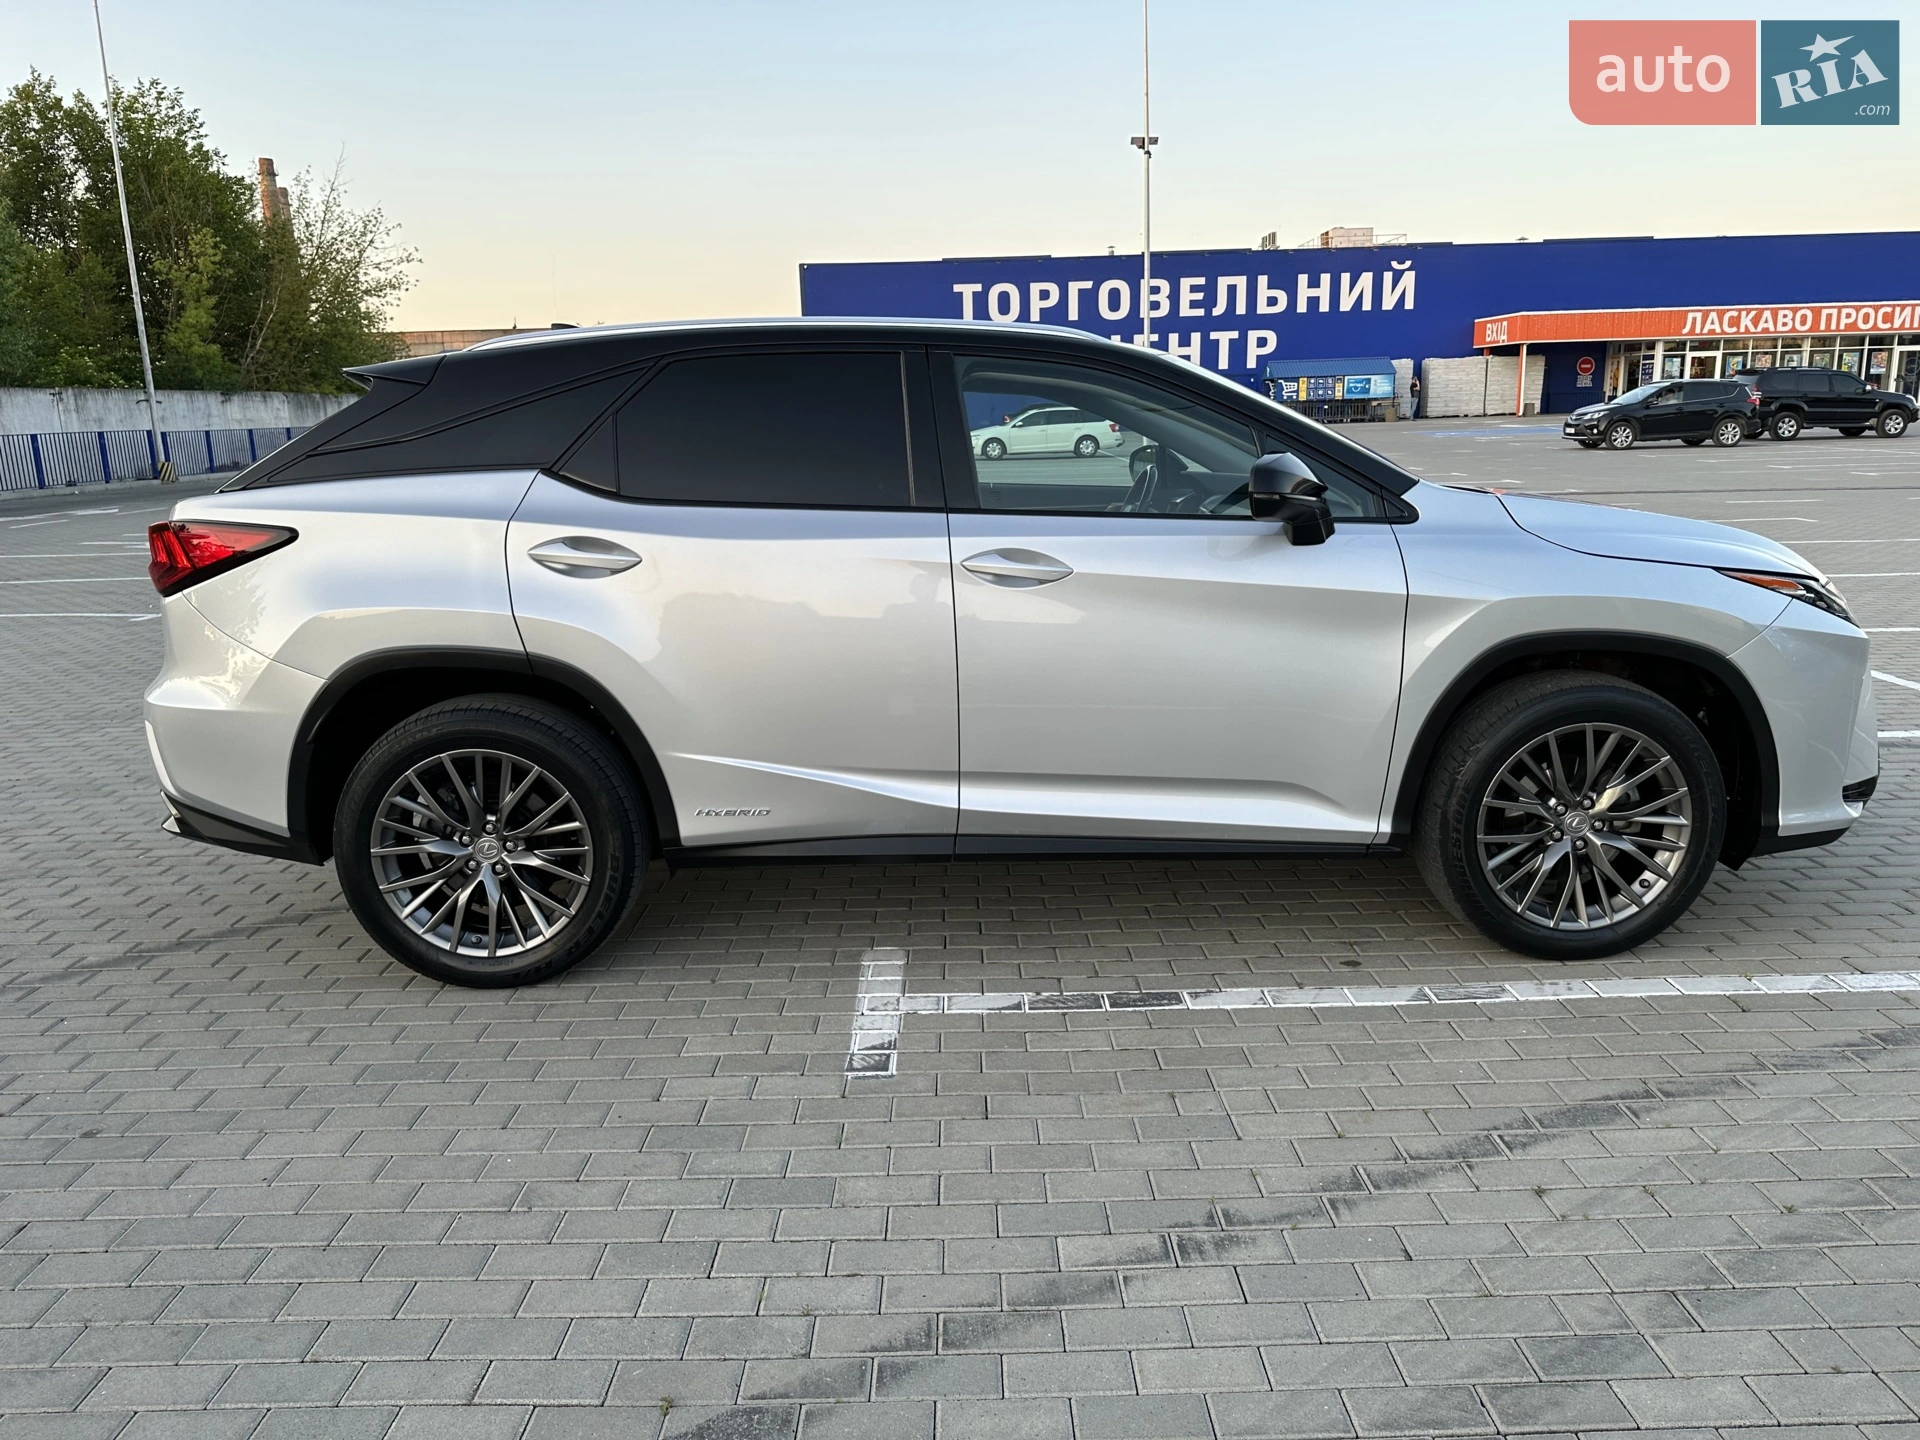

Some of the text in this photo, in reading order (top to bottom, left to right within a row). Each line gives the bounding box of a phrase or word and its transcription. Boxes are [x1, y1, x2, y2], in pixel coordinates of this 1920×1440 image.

[953, 260, 1416, 322] ТОРГОВЕЛЬНИЙ
[1485, 320, 1508, 343] ВХІД
[1682, 305, 1920, 334] ЛАСКАВО ПРОСИ
[694, 807, 772, 817] HYBRID
